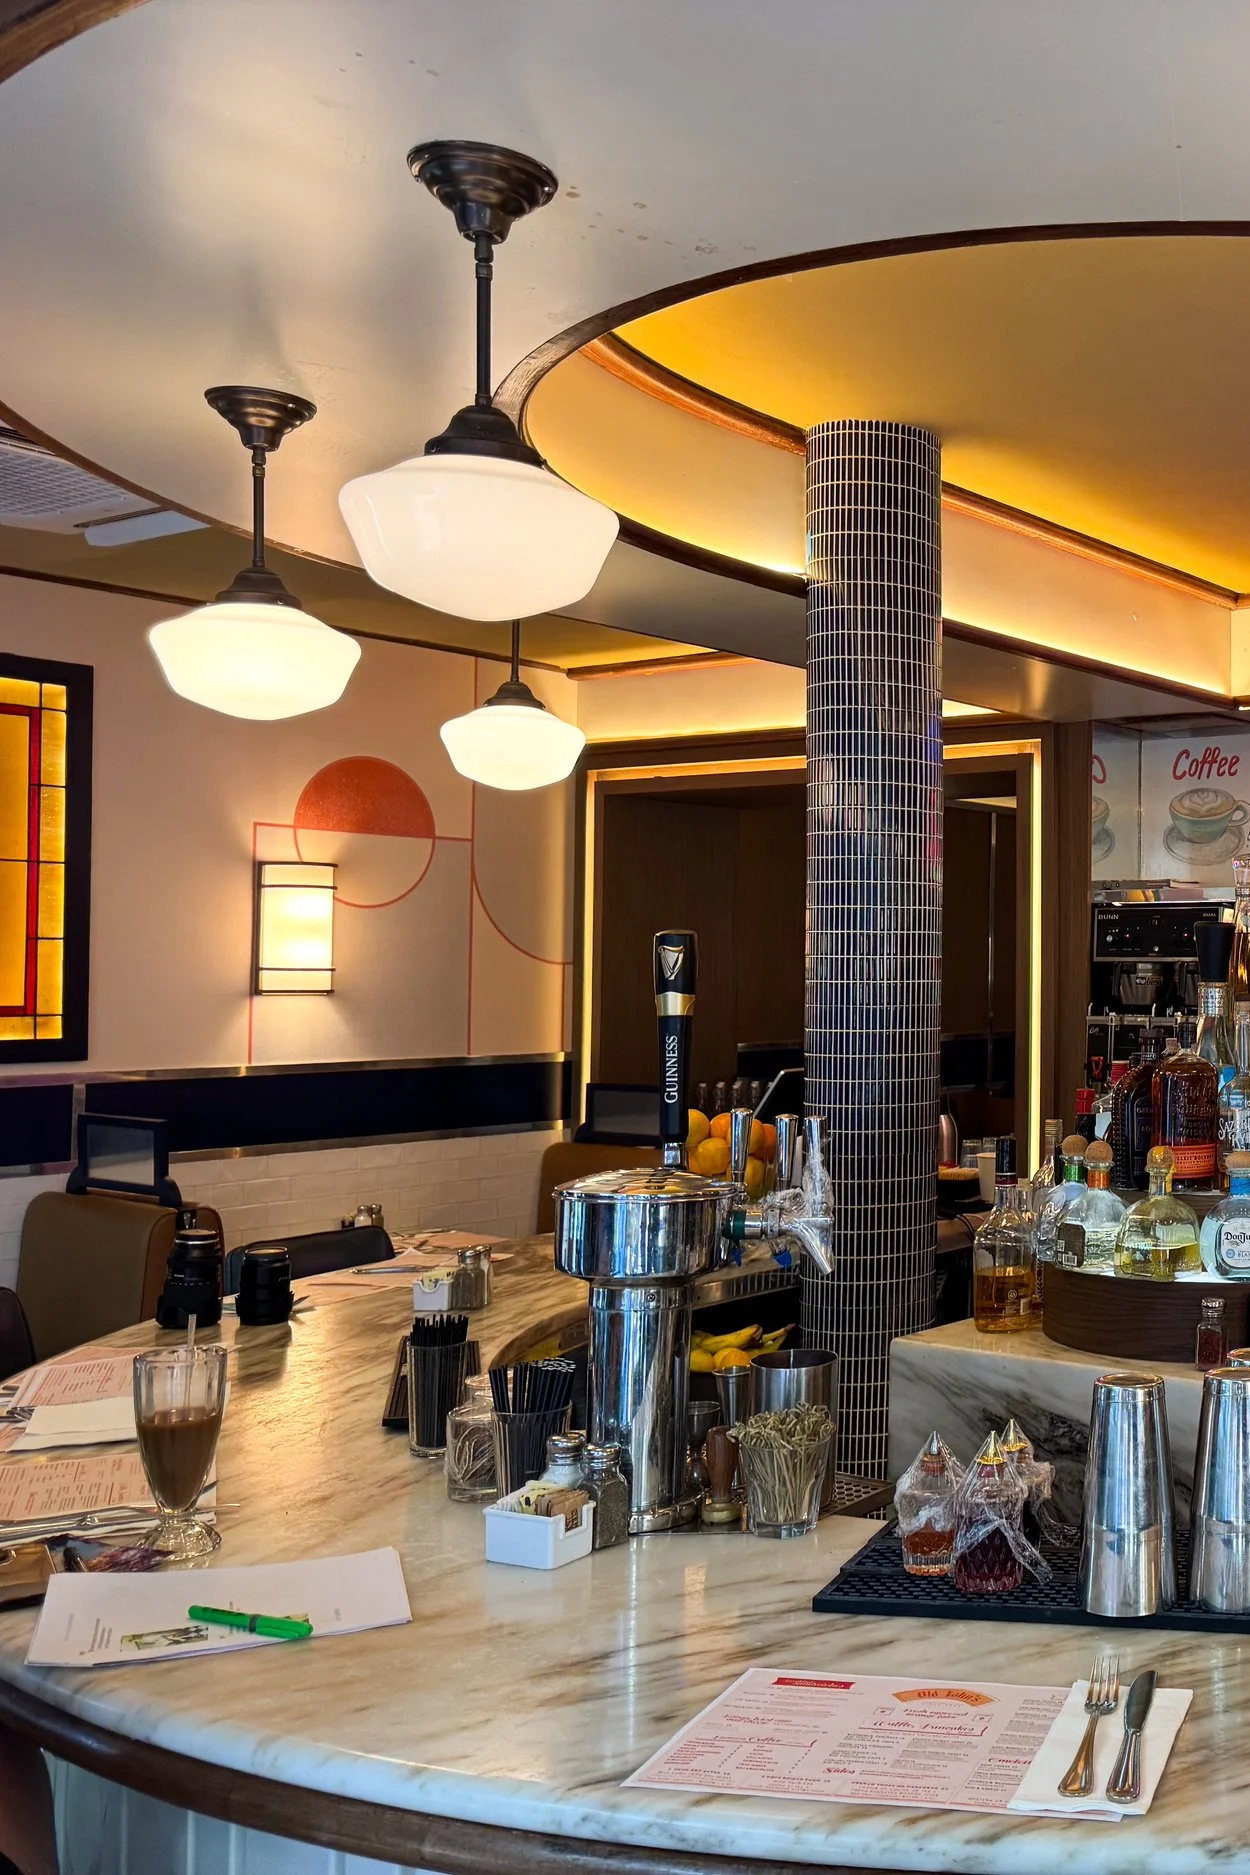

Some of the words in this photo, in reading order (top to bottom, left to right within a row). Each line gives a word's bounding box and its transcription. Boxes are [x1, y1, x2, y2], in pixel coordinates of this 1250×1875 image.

[1172, 746, 1241, 781] Coffee
[664, 1034, 679, 1104] GUINNESS
[917, 1690, 939, 1699] Old
[944, 1690, 980, 1703] John's
